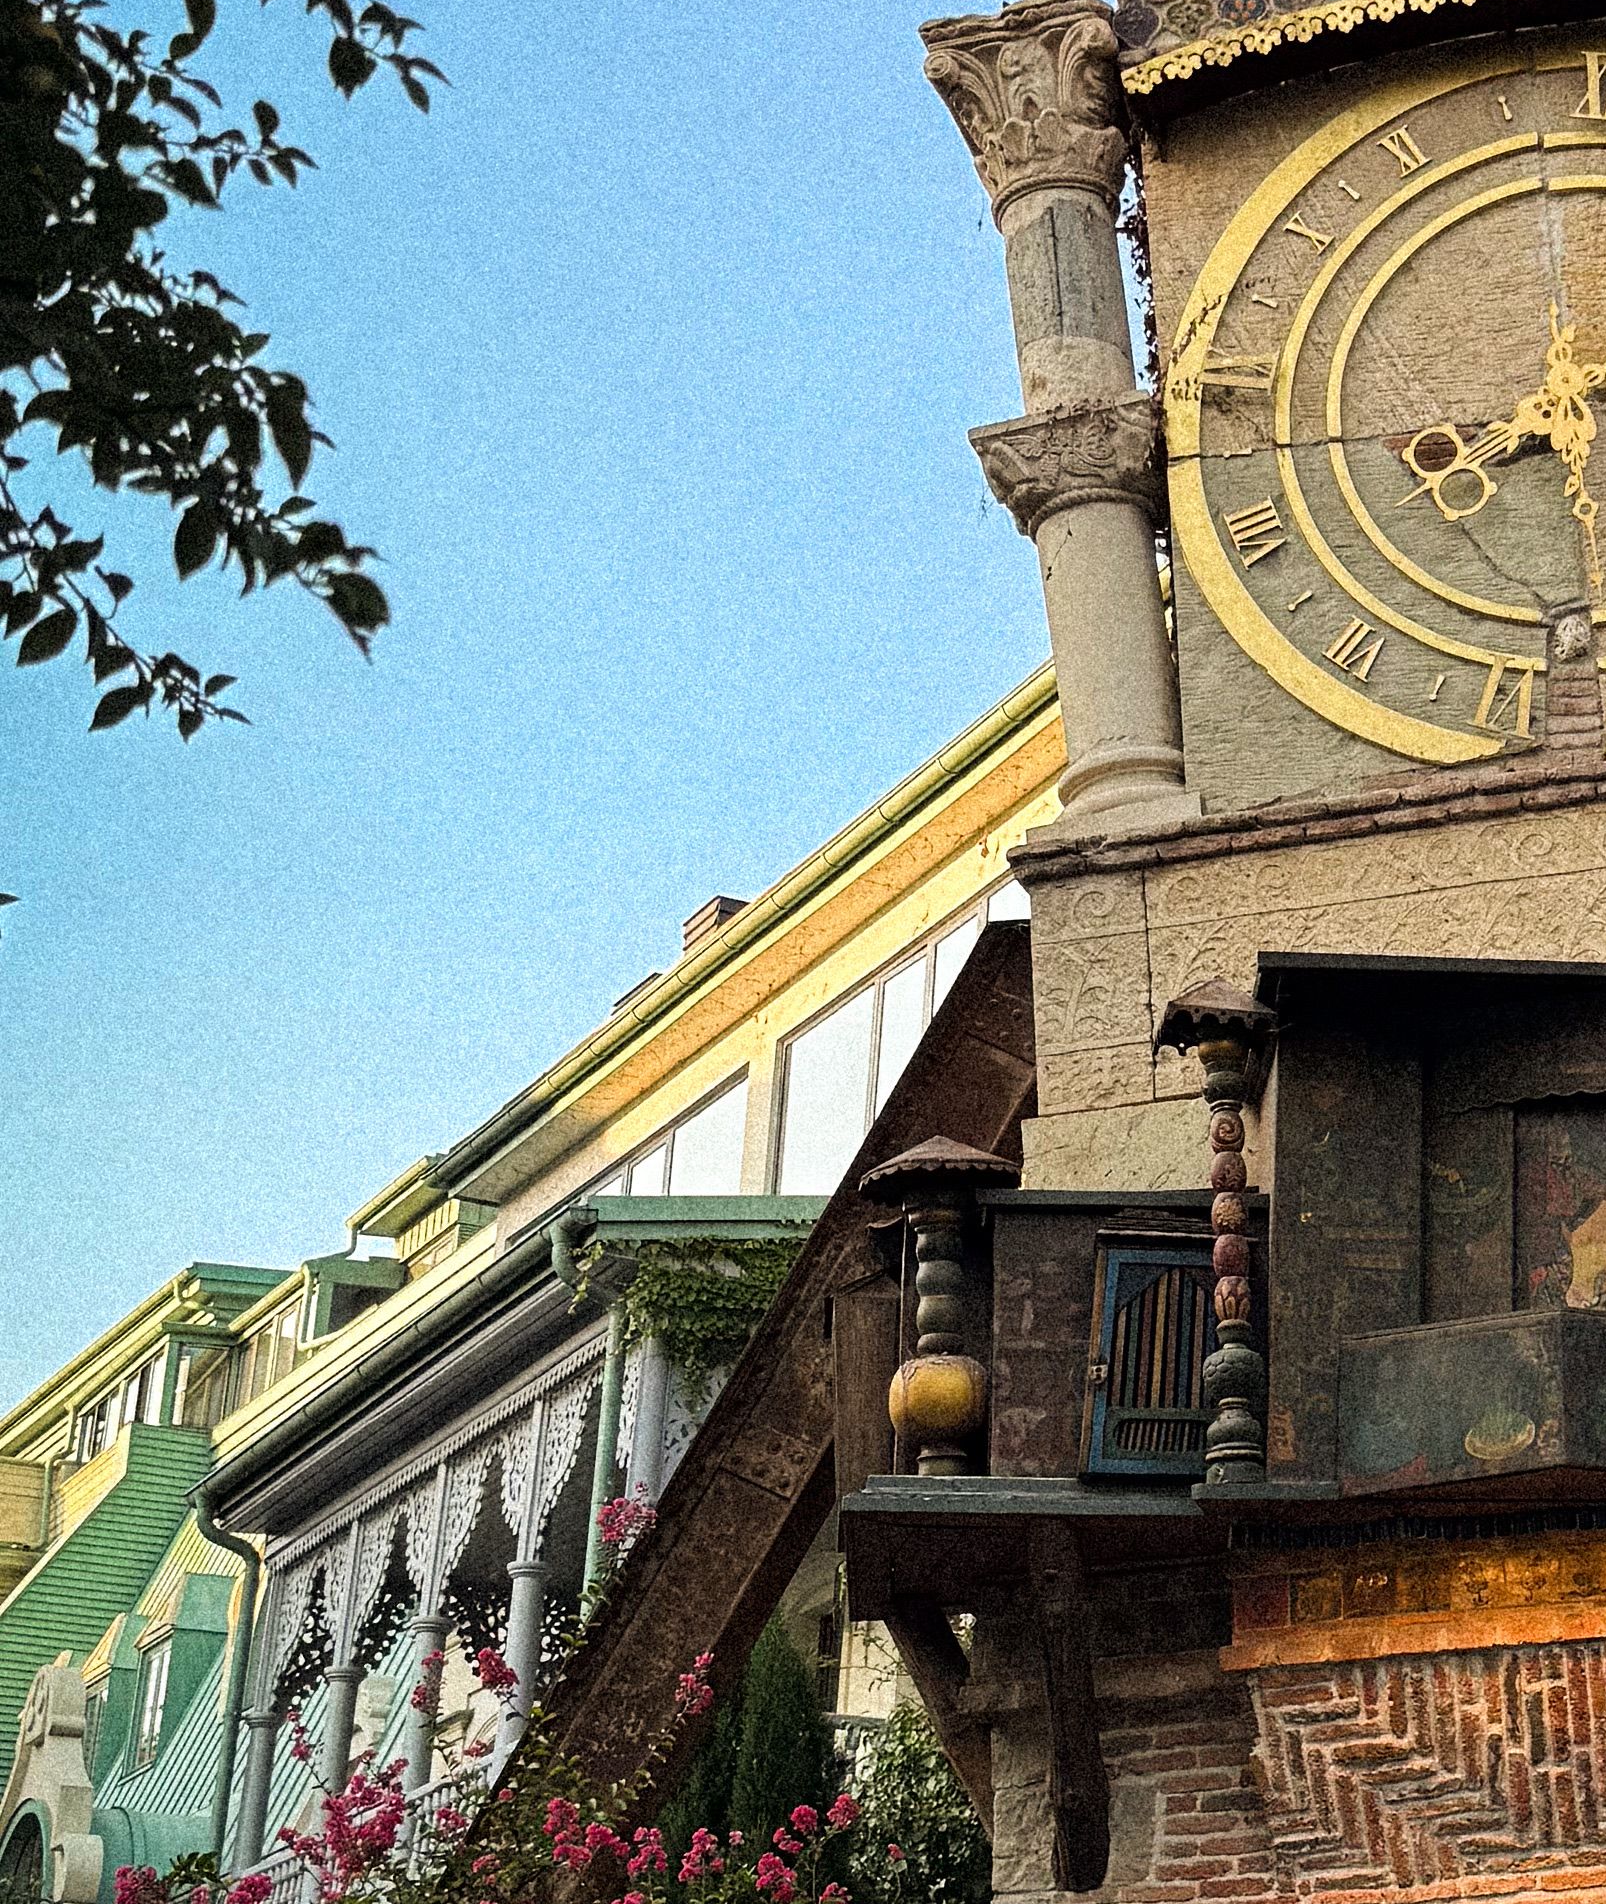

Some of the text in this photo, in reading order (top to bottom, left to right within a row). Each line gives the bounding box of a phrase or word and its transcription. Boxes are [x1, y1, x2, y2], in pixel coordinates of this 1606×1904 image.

[1376, 124, 1432, 179] XI
[1283, 210, 1335, 256] X
[1199, 344, 1281, 397] IX
[1223, 496, 1287, 571] VIII
[1321, 615, 1386, 683] VII
[1465, 653, 1536, 741] VI
